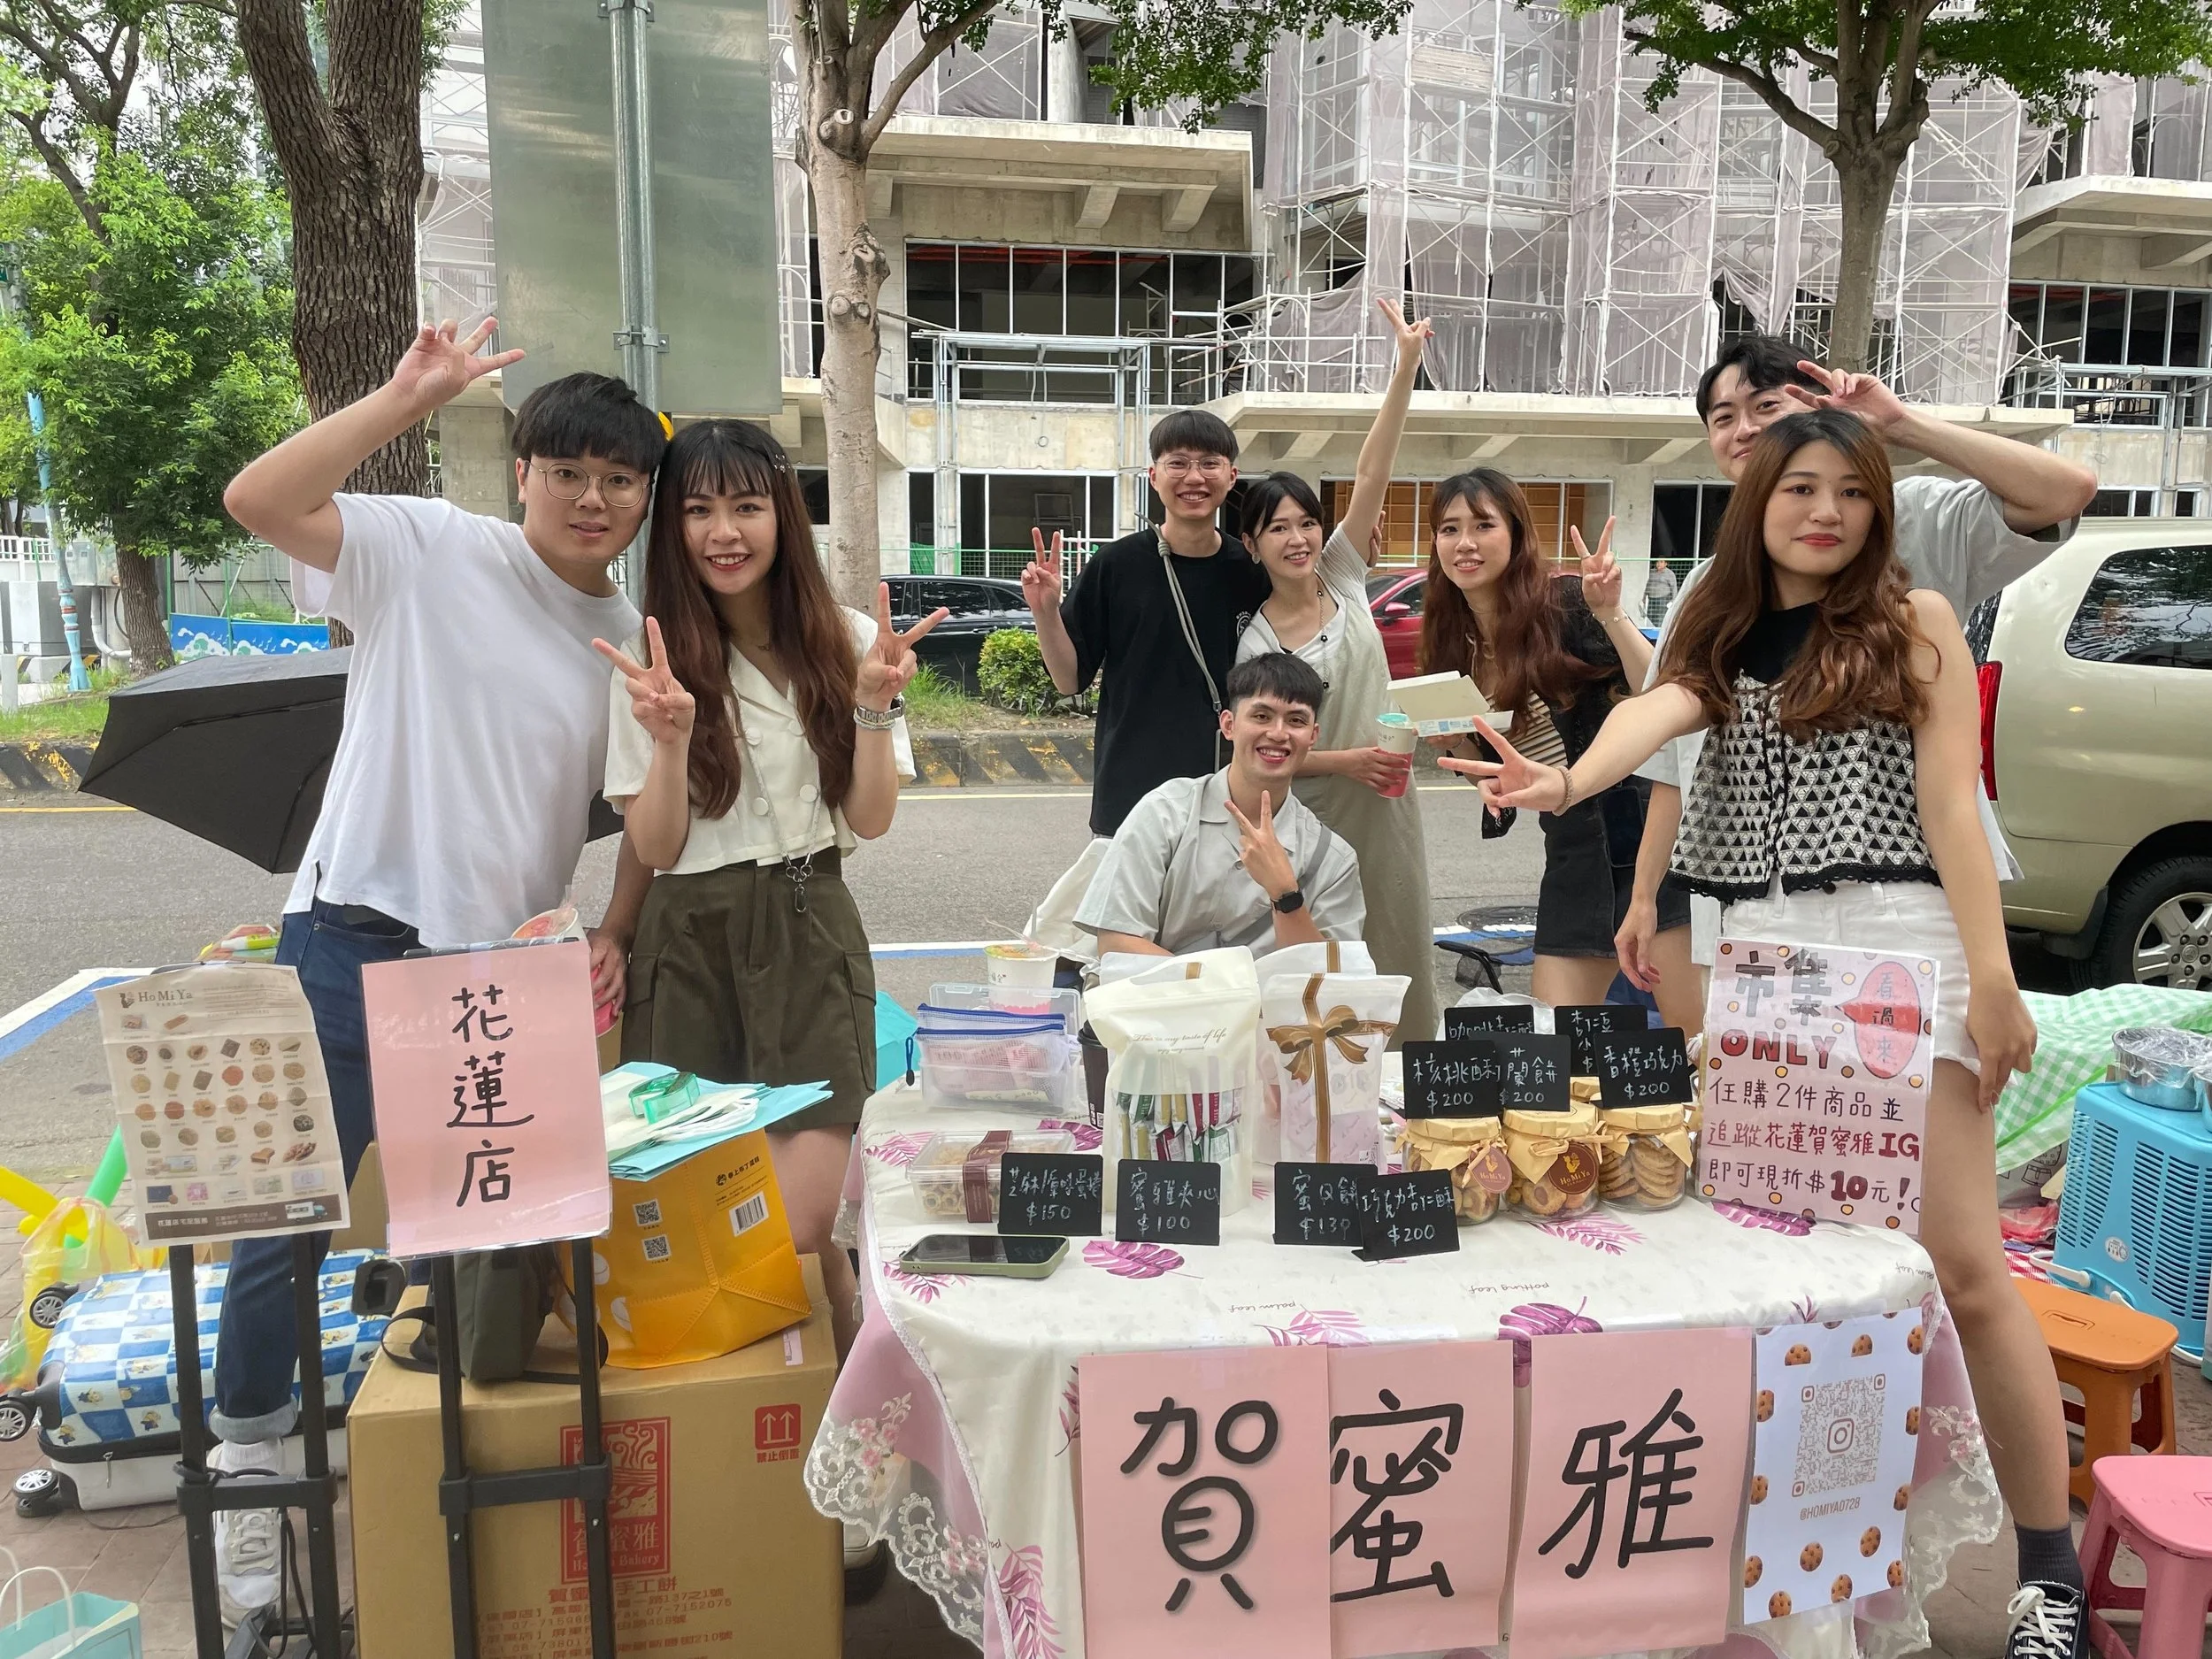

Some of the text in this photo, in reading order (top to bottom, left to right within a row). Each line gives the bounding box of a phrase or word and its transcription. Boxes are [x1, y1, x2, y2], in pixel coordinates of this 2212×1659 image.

[1735, 949, 1832, 1025] 市集
[1871, 972, 1895, 1064] 看過來
[1202, 1028, 1214, 1044] of
[1213, 1026, 1227, 1043] life
[1721, 1029, 1837, 1070] ONLY
[1603, 1045, 1684, 1079] 香橙巧克力
[447, 984, 534, 1207] 花蓮店
[1426, 1089, 1474, 1115] $200
[1499, 1087, 1546, 1105] $200
[1624, 1081, 1671, 1100] $200
[1709, 1077, 1903, 1122] 任購2件商品並
[1026, 1202, 1071, 1226] $150
[1137, 1213, 1191, 1237] $100
[1387, 1224, 1436, 1247] $200
[1468, 1285, 1497, 1294] leaf
[1228, 1304, 1256, 1313] leaf
[1799, 1496, 1862, 1521] @HOMIYA0728
